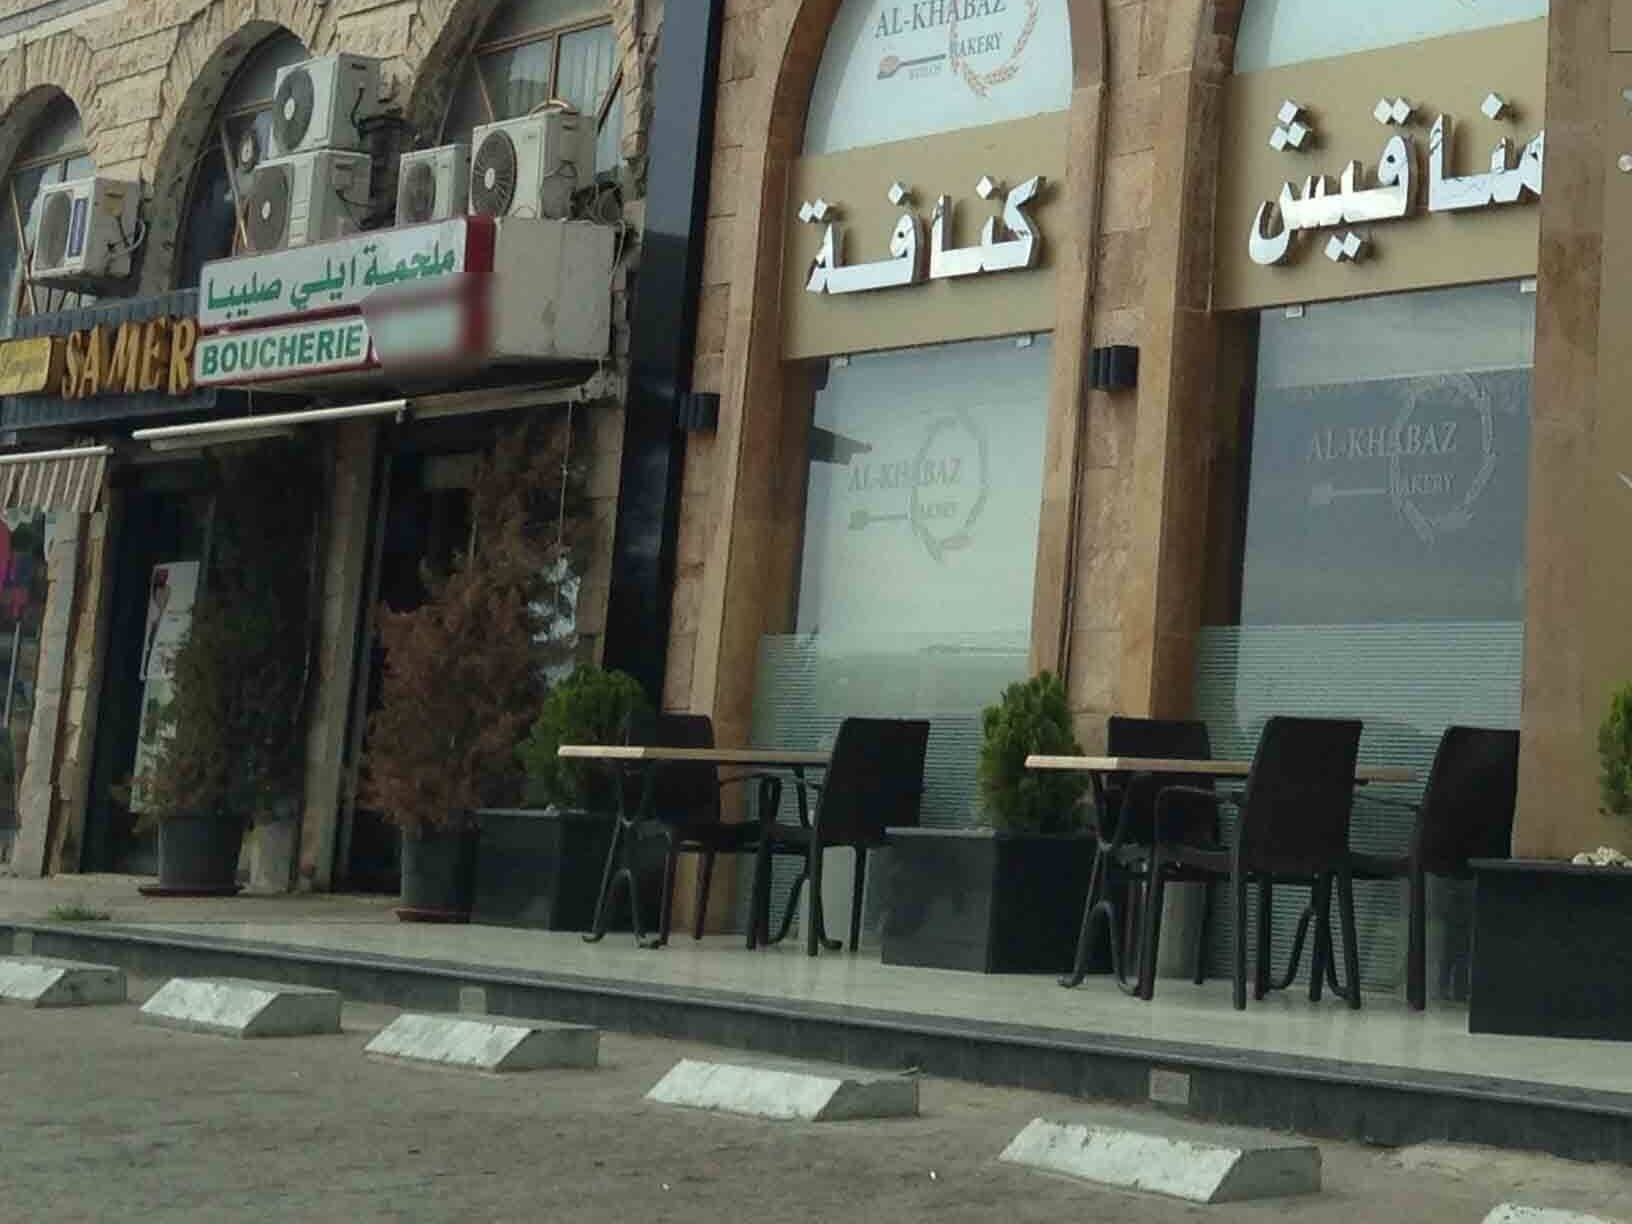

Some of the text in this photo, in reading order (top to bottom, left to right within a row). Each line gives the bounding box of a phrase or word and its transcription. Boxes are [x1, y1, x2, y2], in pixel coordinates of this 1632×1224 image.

[799, 176, 1042, 295] كنافة
[61, 316, 198, 400] SAMER
[201, 324, 364, 376] BOUCHERIE
